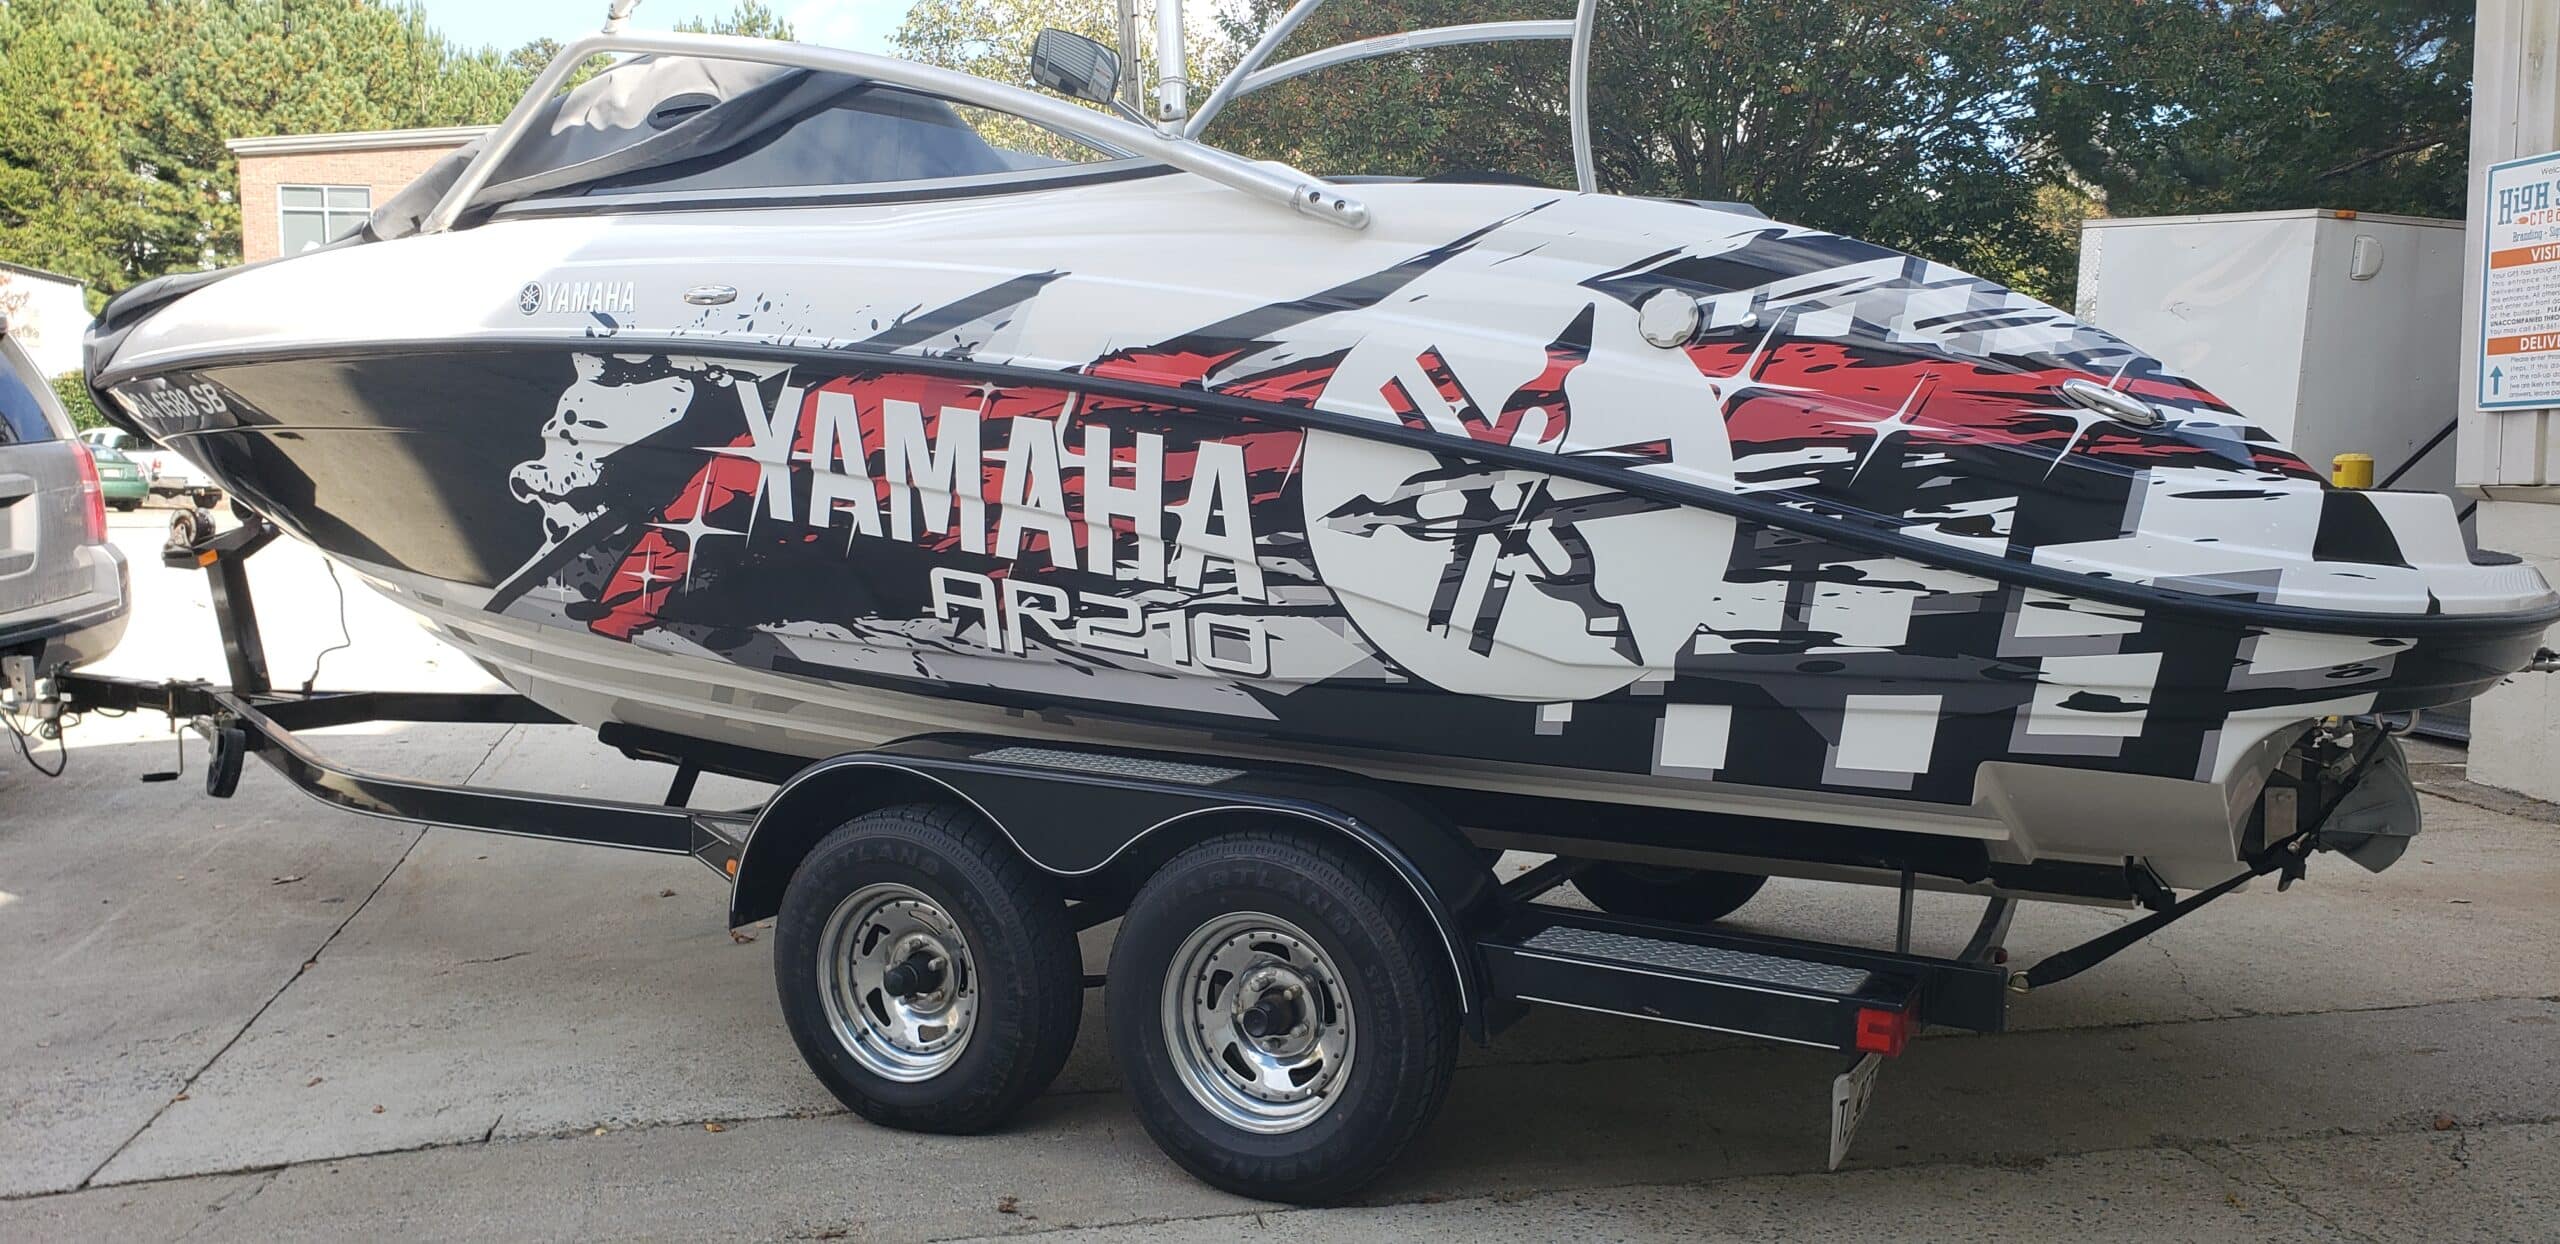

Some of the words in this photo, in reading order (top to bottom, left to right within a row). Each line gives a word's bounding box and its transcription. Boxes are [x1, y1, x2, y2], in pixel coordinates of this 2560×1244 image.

[546, 281, 636, 313] YAMAHA
[188, 383, 228, 415] SB
[733, 367, 1266, 603] YAMAHA
[929, 566, 1271, 677] AR210
